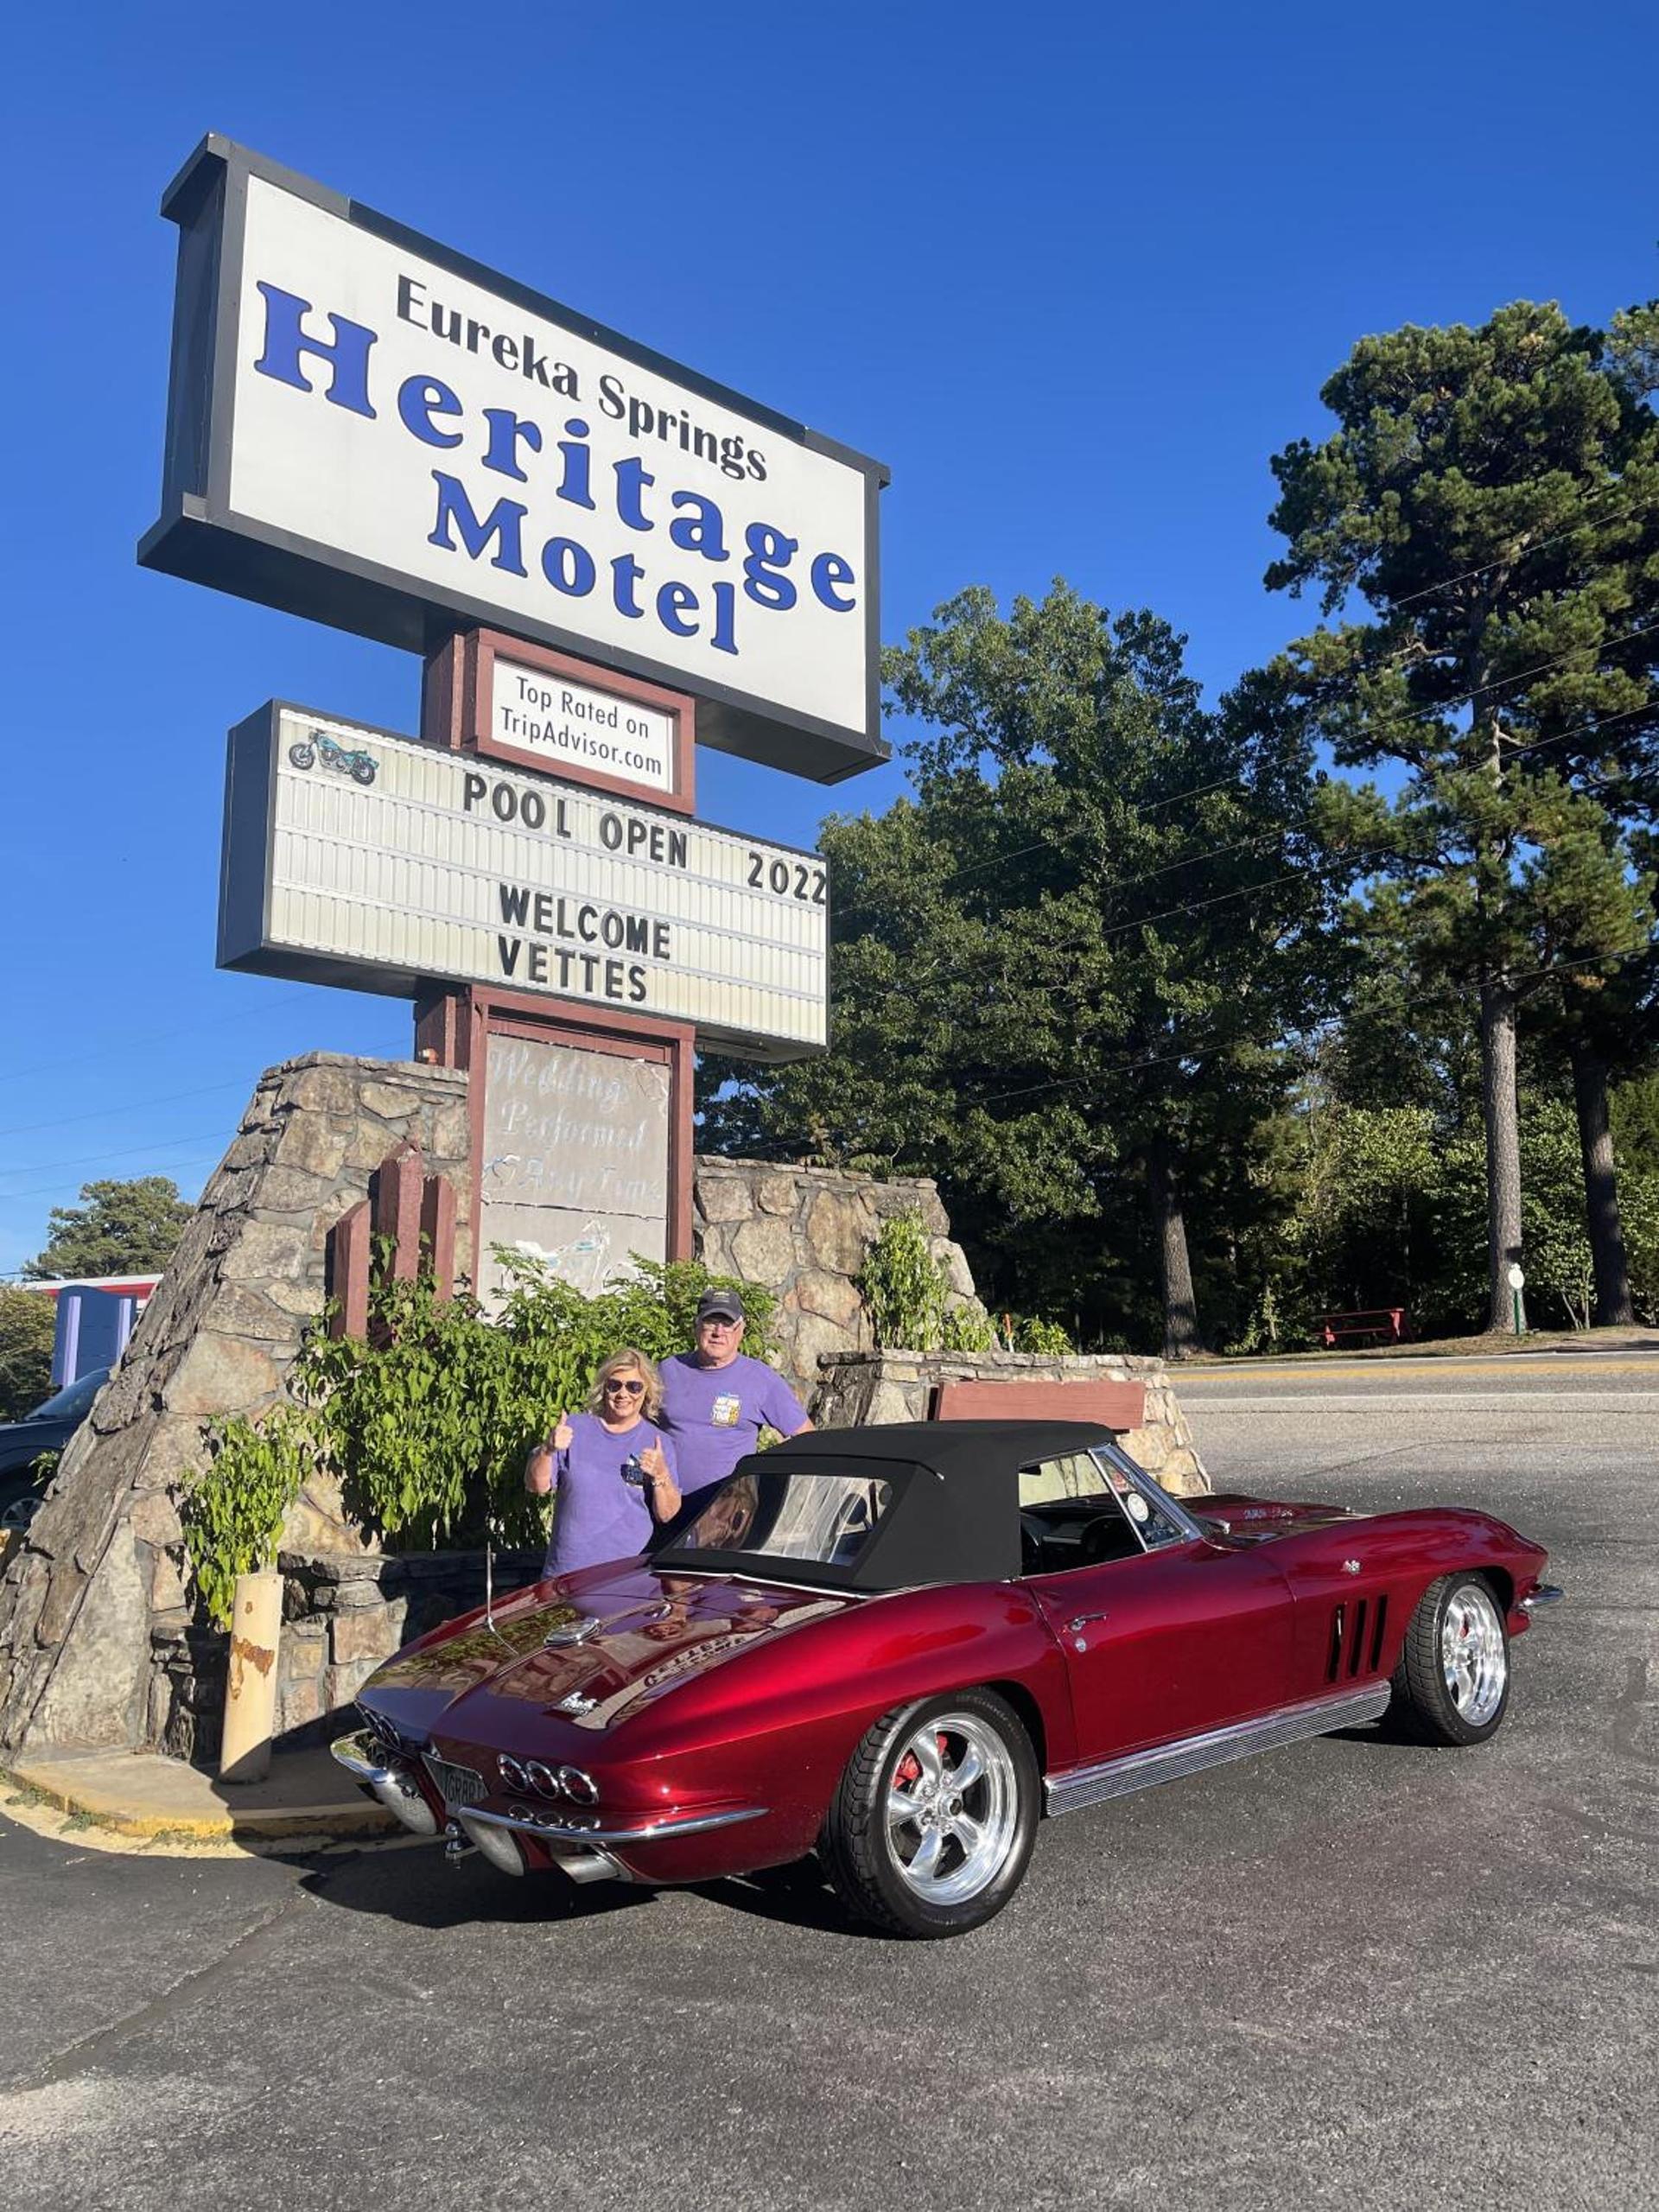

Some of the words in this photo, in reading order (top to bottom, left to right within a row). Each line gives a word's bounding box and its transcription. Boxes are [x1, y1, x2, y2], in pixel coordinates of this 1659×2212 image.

[397, 274, 581, 402] Eureka
[598, 374, 767, 481] Springs
[253, 280, 856, 613] Heritage
[427, 469, 739, 656] Motel
[501, 706, 663, 777] TripAdvisor.com
[516, 677, 553, 712] Top
[562, 690, 619, 729] Rated
[626, 720, 650, 739] on
[463, 772, 572, 839] POOL
[601, 816, 688, 868] OPEN
[747, 852, 827, 906] 2022
[497, 935, 647, 1003] VETTES
[499, 882, 671, 961] WELCOME
